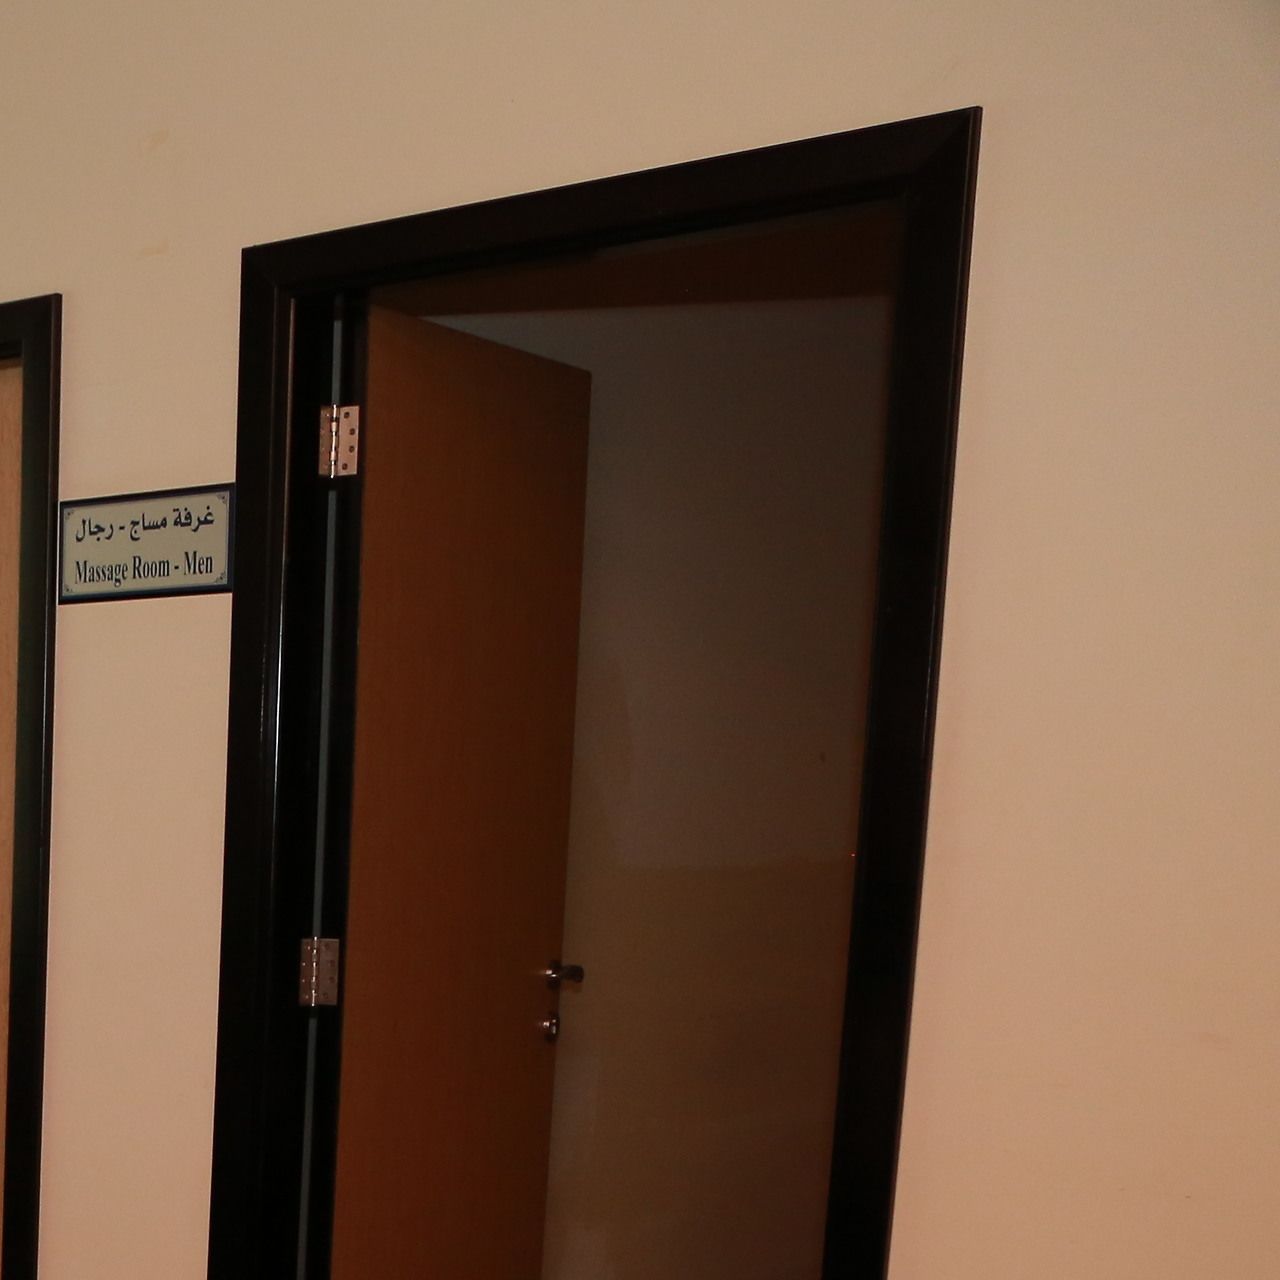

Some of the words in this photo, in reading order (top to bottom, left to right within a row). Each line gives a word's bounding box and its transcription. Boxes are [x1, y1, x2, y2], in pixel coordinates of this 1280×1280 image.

[75, 519, 113, 542] رجال
[130, 513, 167, 541] مساج
[173, 505, 215, 532] غرفة
[75, 560, 128, 587] Massage
[133, 555, 170, 579] Room
[184, 551, 213, 575] Men
